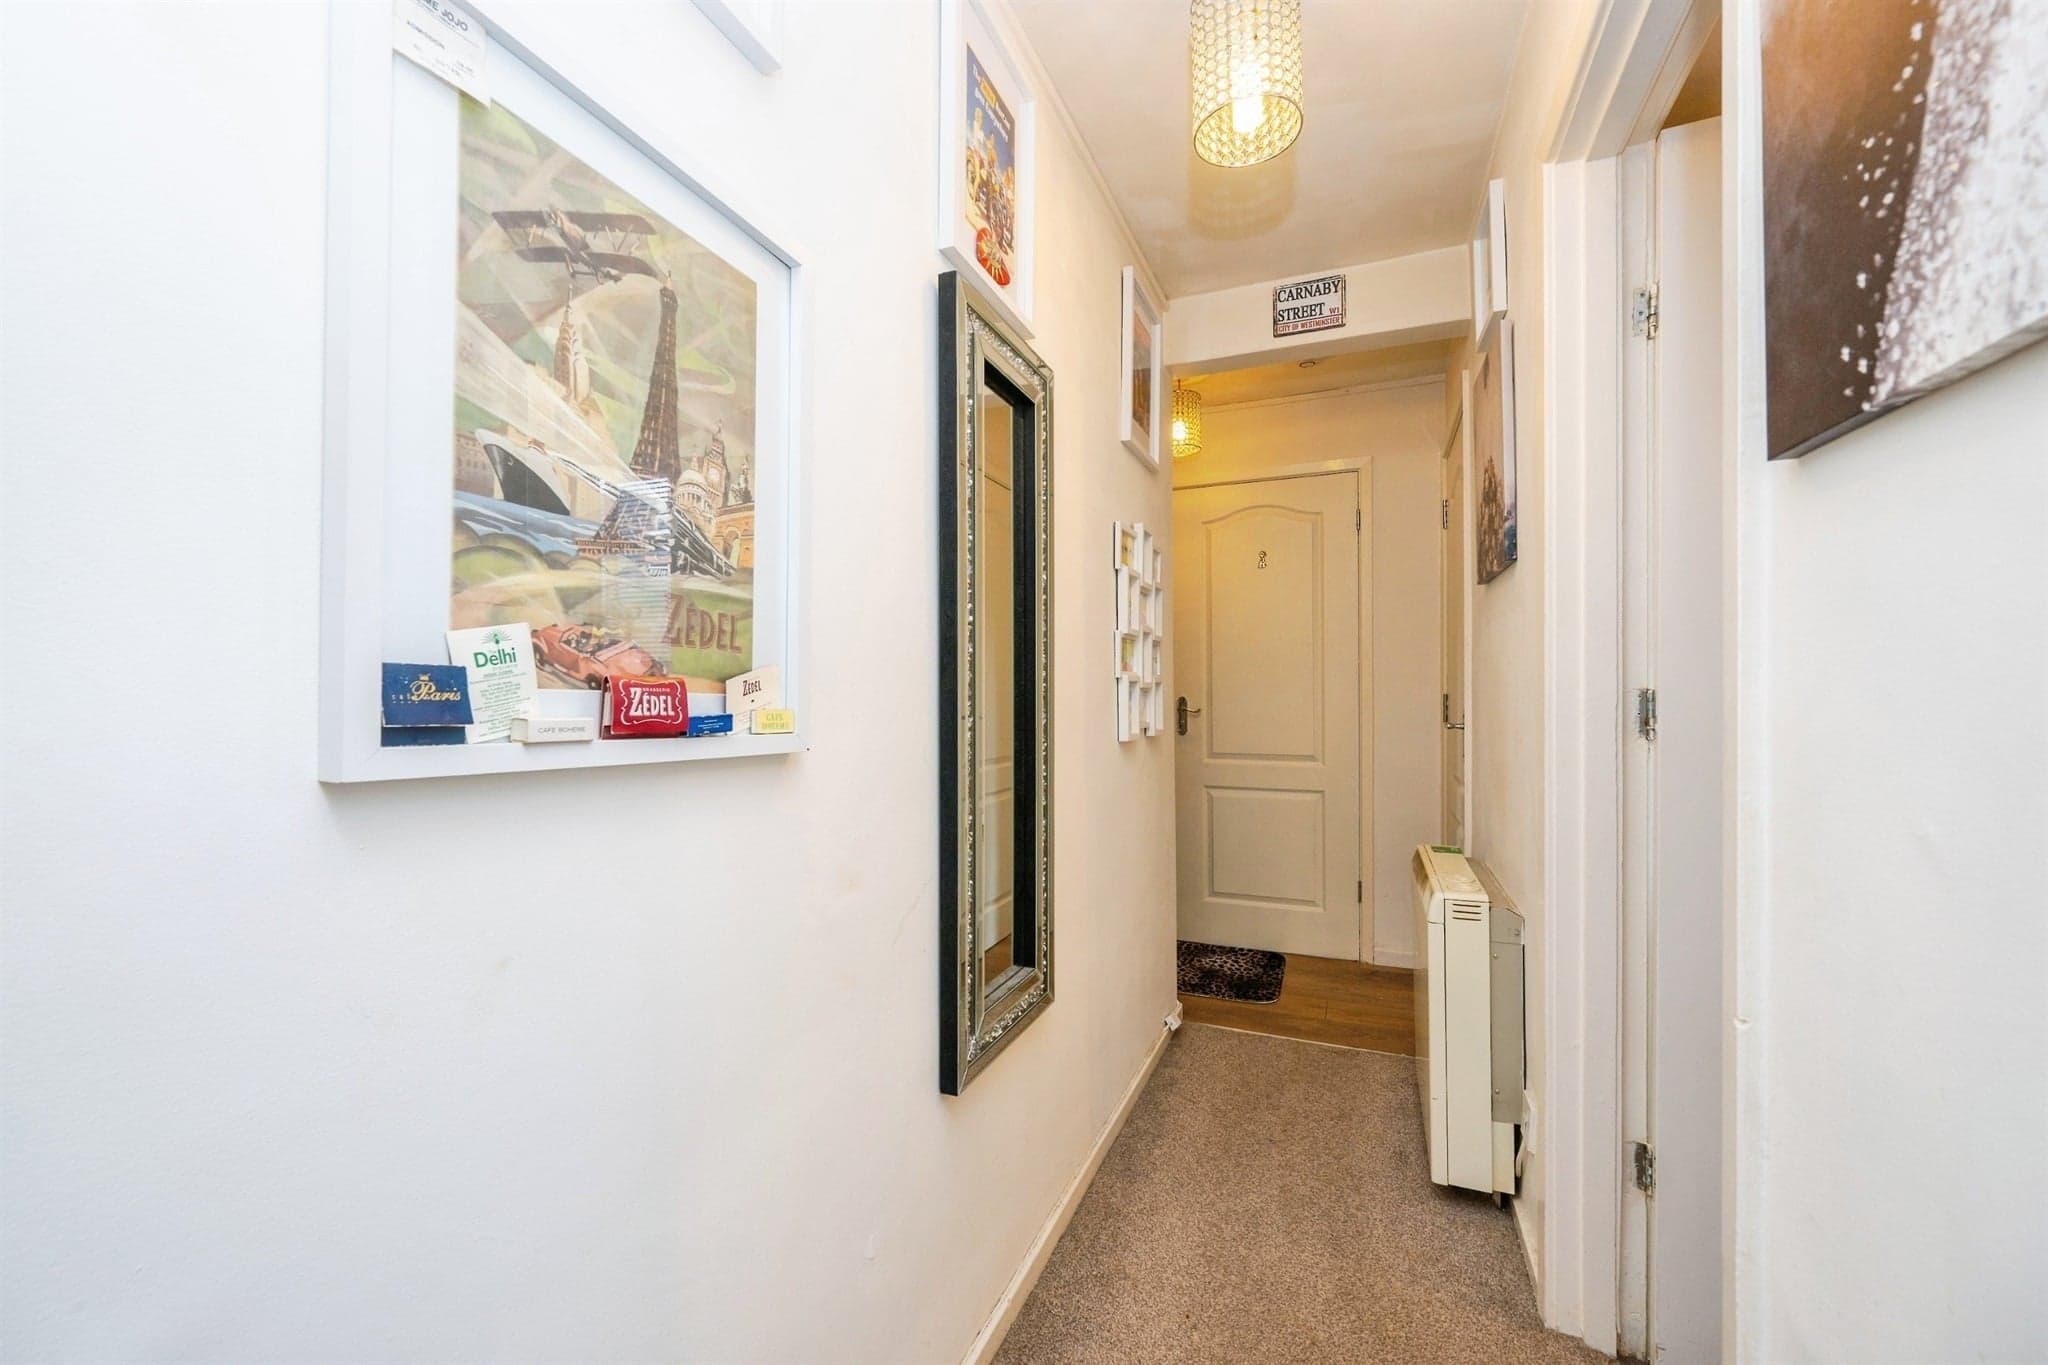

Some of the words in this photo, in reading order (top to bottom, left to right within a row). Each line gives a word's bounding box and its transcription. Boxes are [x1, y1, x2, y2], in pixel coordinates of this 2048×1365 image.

[1278, 280, 1340, 302] CARNABY
[1278, 303, 1325, 322] STREET
[1278, 324, 1291, 333] CITY
[1300, 316, 1340, 329] WESTMINSTER
[473, 647, 517, 668] Delhi
[410, 681, 460, 700] Paris
[629, 687, 675, 716] ZÉDEL
